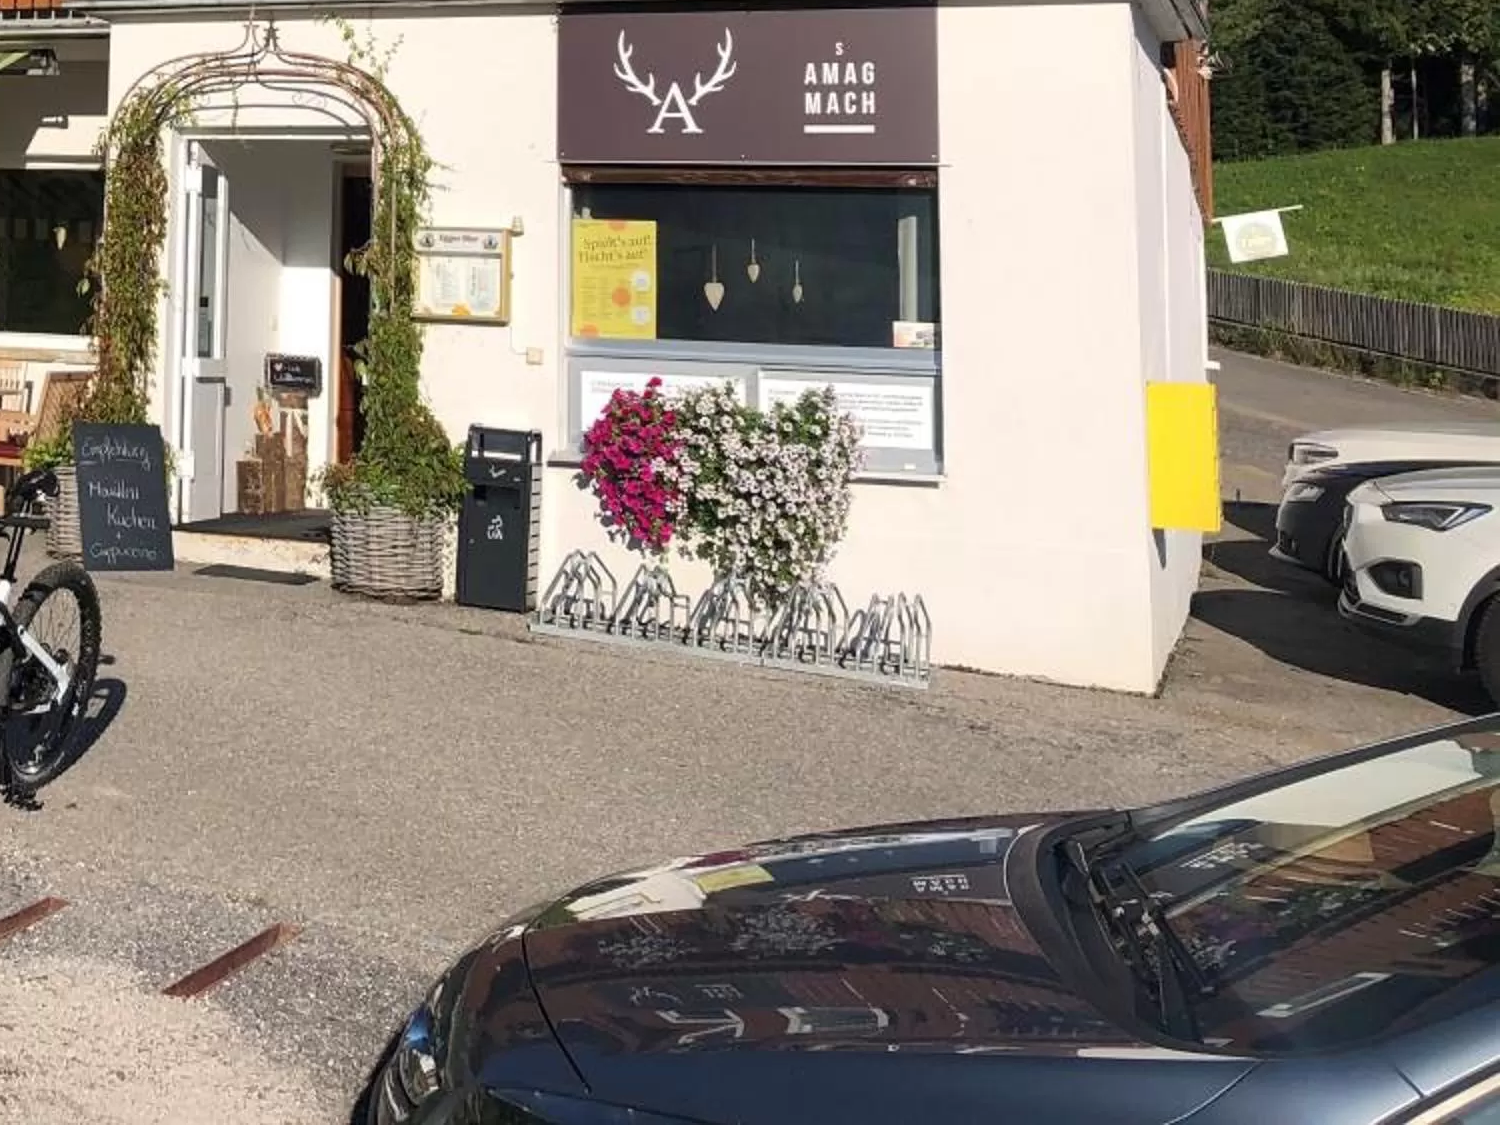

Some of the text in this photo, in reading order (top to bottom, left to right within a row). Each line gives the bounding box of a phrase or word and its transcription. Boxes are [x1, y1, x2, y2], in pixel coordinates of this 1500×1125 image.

[803, 61, 876, 85] AMAG
[804, 90, 876, 114] MACH
[107, 502, 157, 530] Kuchen
